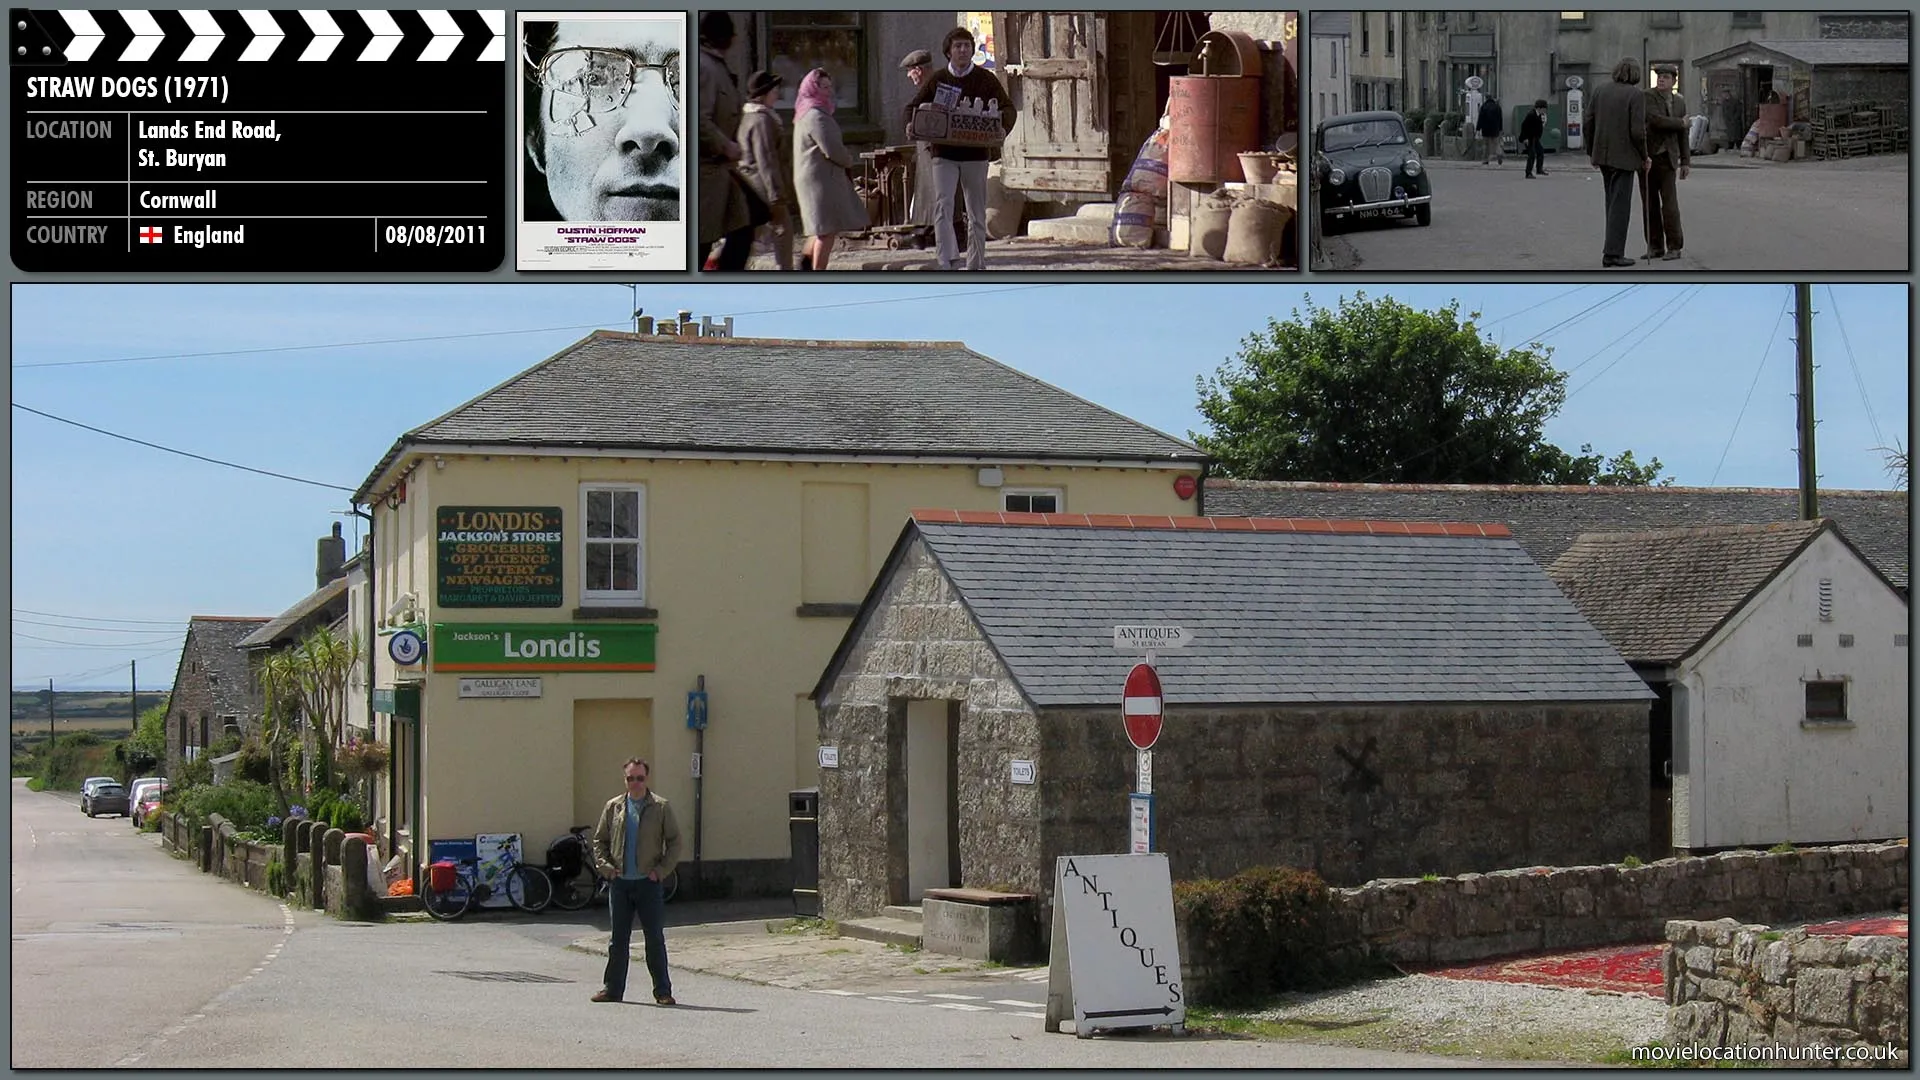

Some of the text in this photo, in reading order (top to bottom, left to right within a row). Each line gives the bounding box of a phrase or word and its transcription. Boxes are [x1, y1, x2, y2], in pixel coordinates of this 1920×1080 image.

[456, 511, 544, 530] LONDIS
[438, 530, 561, 542] JACKSON'S STORES
[455, 543, 545, 553] GROCERIES
[450, 554, 550, 564] OFF LICENCE
[463, 564, 540, 574] LOTTERY
[446, 575, 554, 585] NEWSAGENTS
[1119, 627, 1181, 640] ANTIQUES
[452, 631, 601, 658] Jackson's Londis
[1063, 858, 1181, 1003] ANTIQUES
